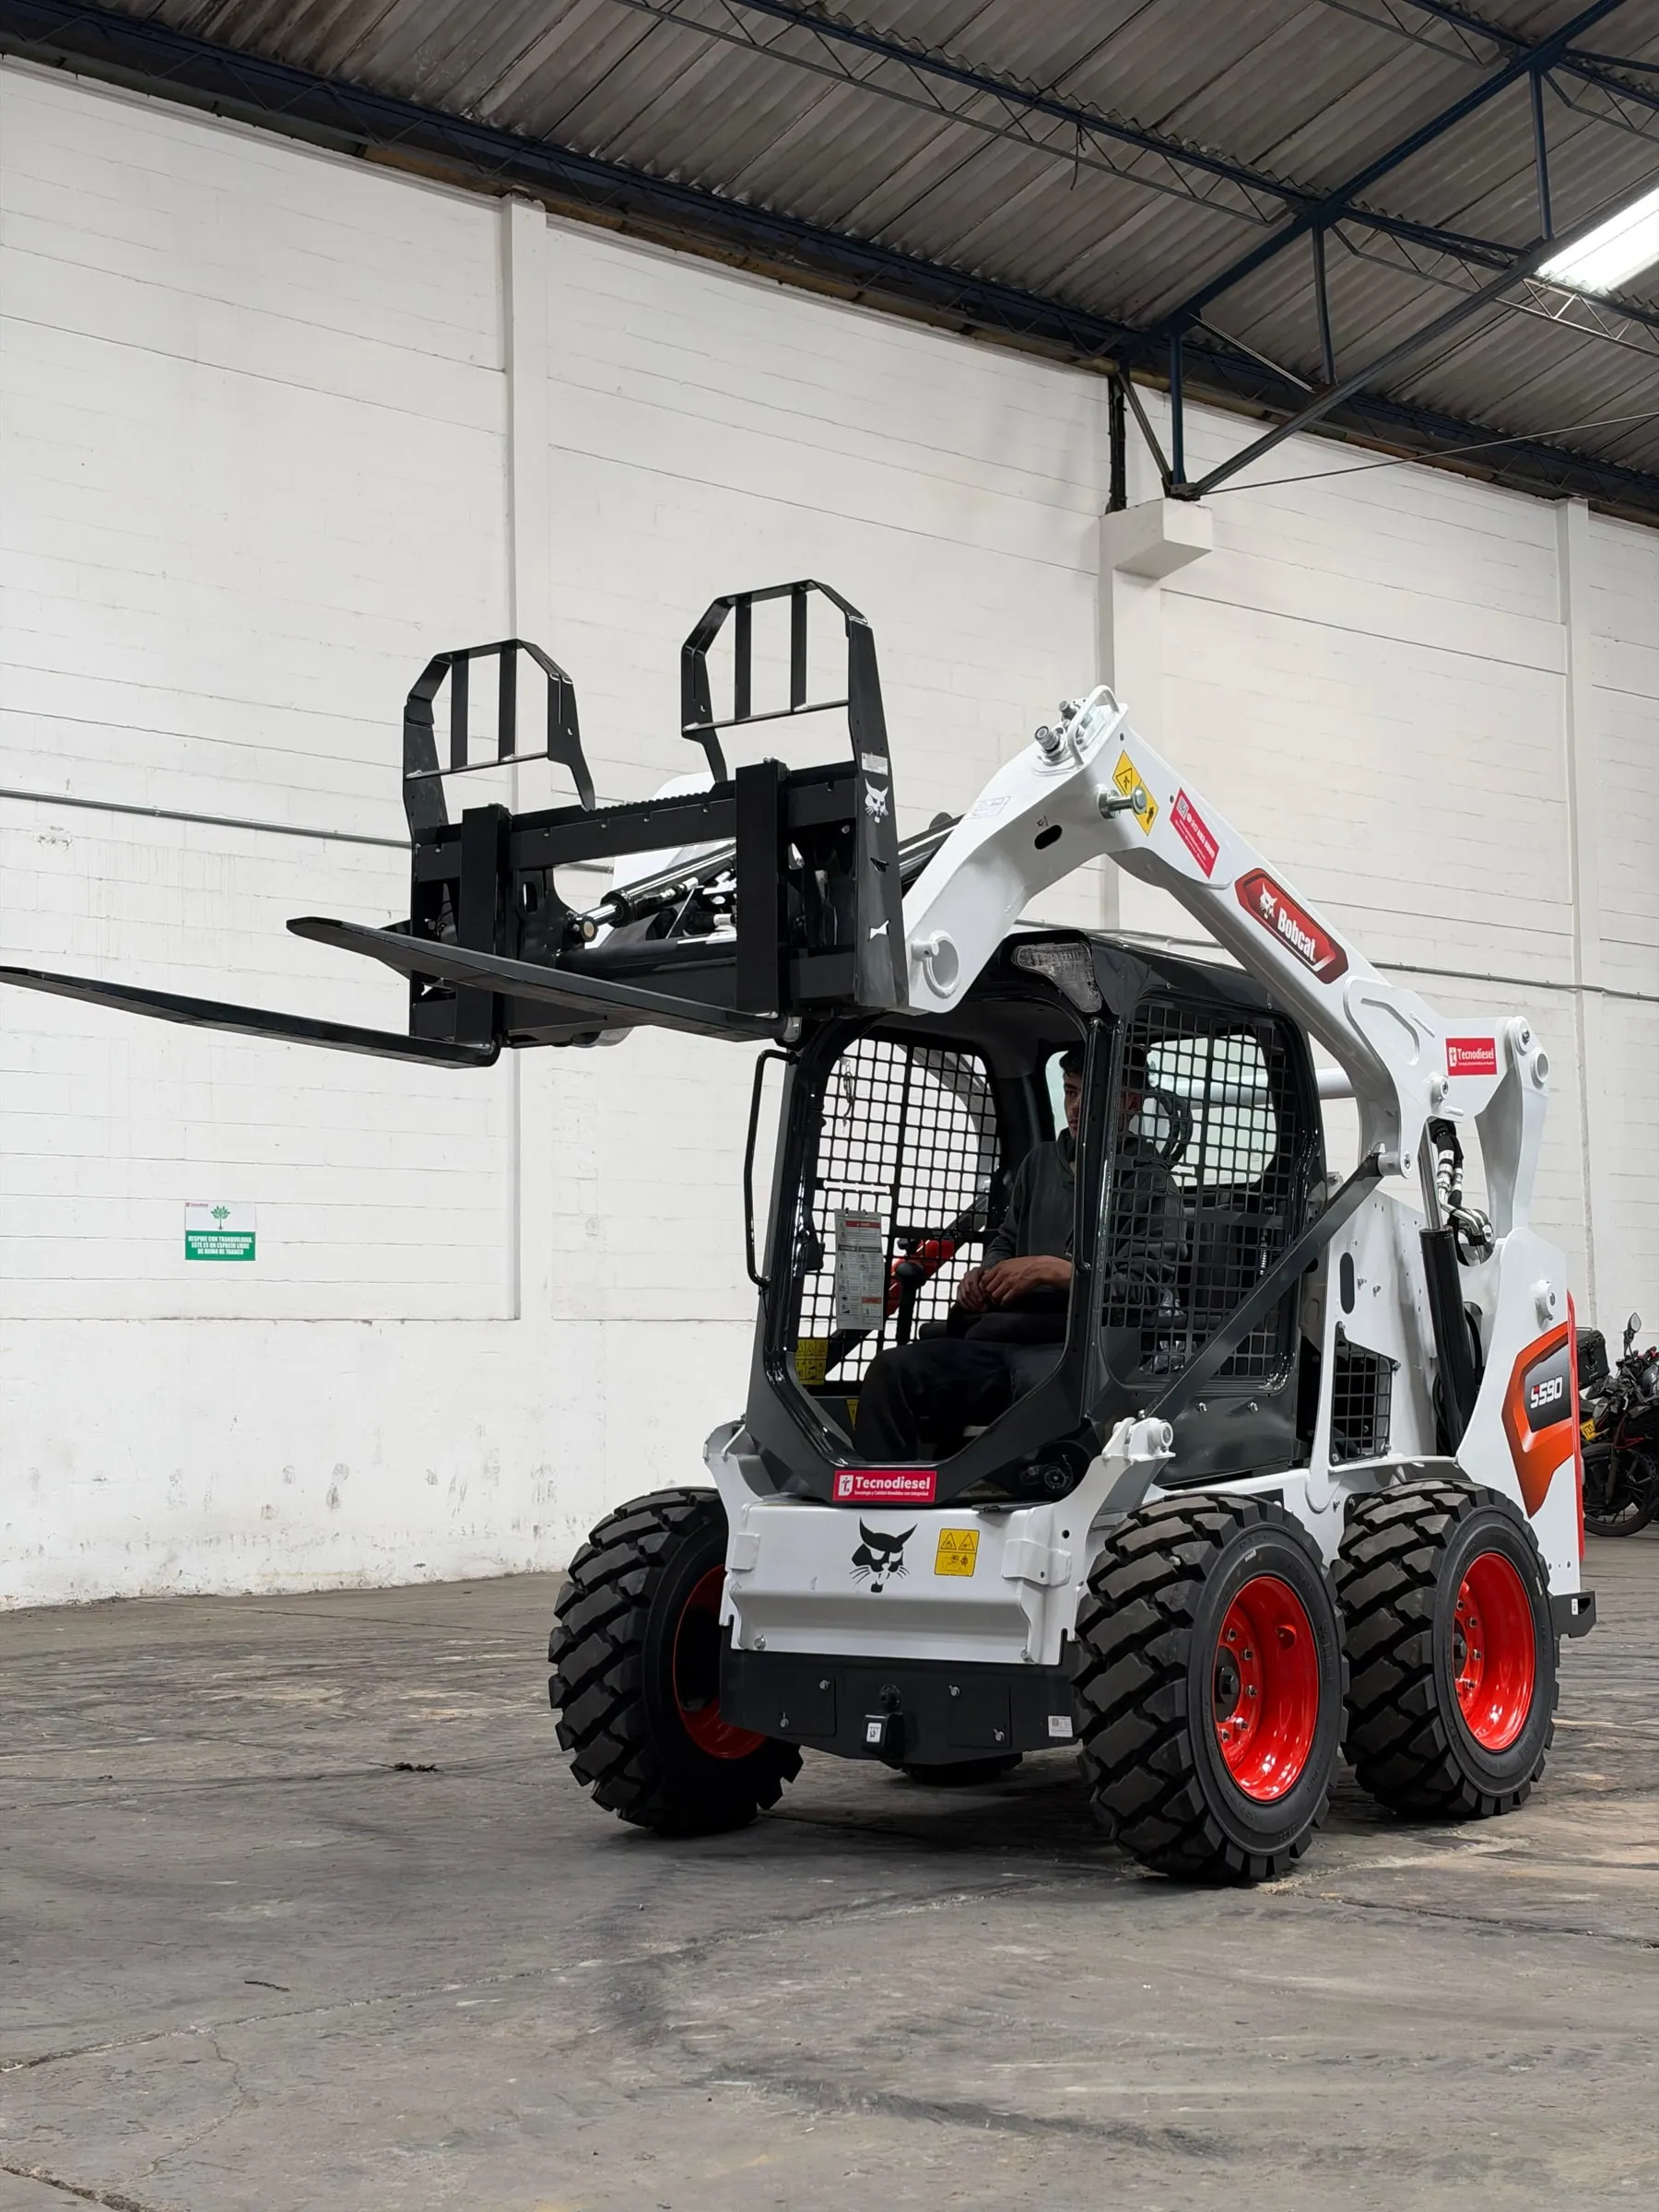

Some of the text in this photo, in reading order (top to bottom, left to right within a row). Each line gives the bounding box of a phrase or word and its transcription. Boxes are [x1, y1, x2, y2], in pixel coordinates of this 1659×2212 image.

[1277, 907, 1315, 961] Bobcat
[1456, 1048, 1494, 1060] Tecnodiesel
[1530, 1376, 1563, 1408] S590
[855, 1476, 931, 1489] Tecnodiesel
